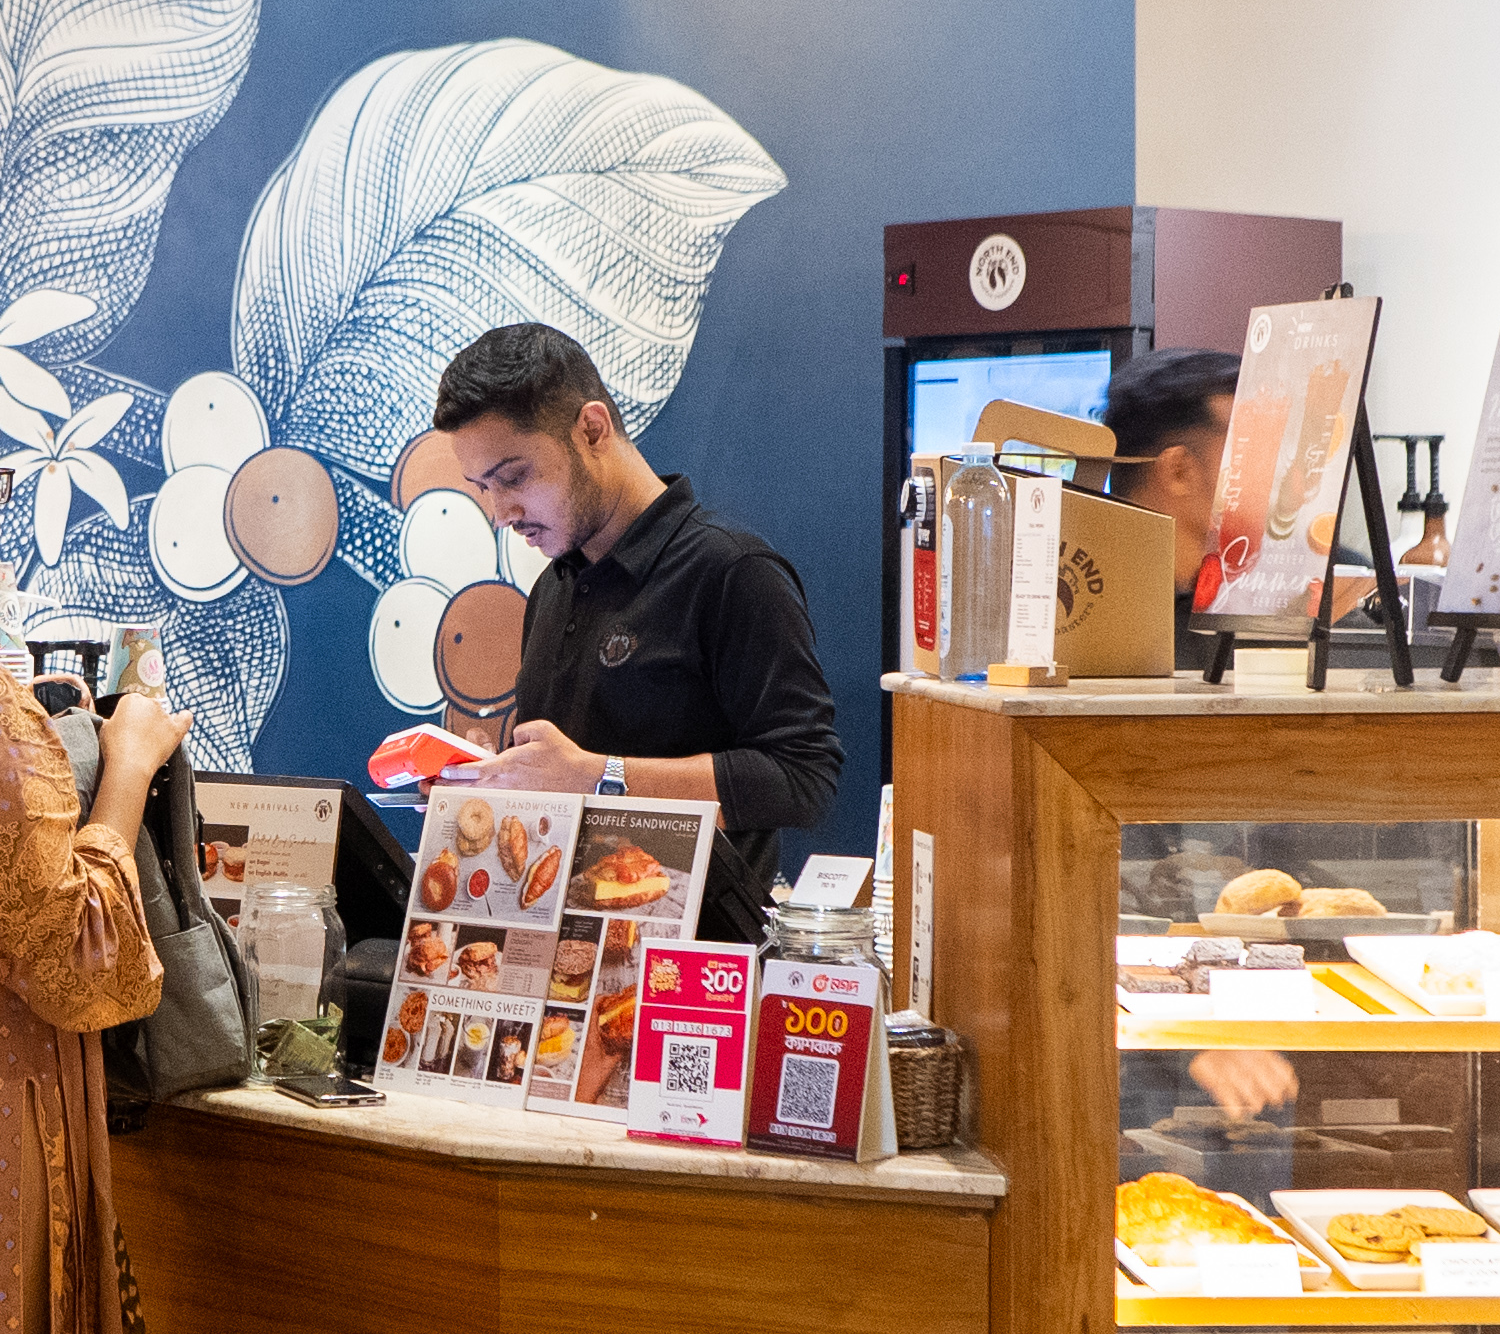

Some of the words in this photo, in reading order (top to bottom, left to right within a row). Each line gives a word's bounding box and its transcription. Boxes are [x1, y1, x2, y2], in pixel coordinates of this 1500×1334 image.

[976, 246, 1004, 277] NORTH
[1006, 249, 1020, 275] END
[1293, 333, 1339, 350] DRINKS
[1071, 548, 1104, 594] END
[1212, 536, 1320, 613] Summer
[1054, 602, 1094, 635] oasters
[230, 802, 249, 810] NEW
[254, 804, 299, 813] ARRIVALS
[505, 800, 569, 813] SANDWICHES
[585, 813, 628, 828] SOUFFLÉ
[630, 817, 699, 832] SANDWICHES
[816, 872, 849, 881] BISCOTTI
[431, 993, 492, 1013] SOMETHING
[496, 1001, 536, 1017] SWEET?
[652, 1020, 672, 1031] 013
[675, 1022, 702, 1034] 1336
[705, 1025, 731, 1036] 1673
